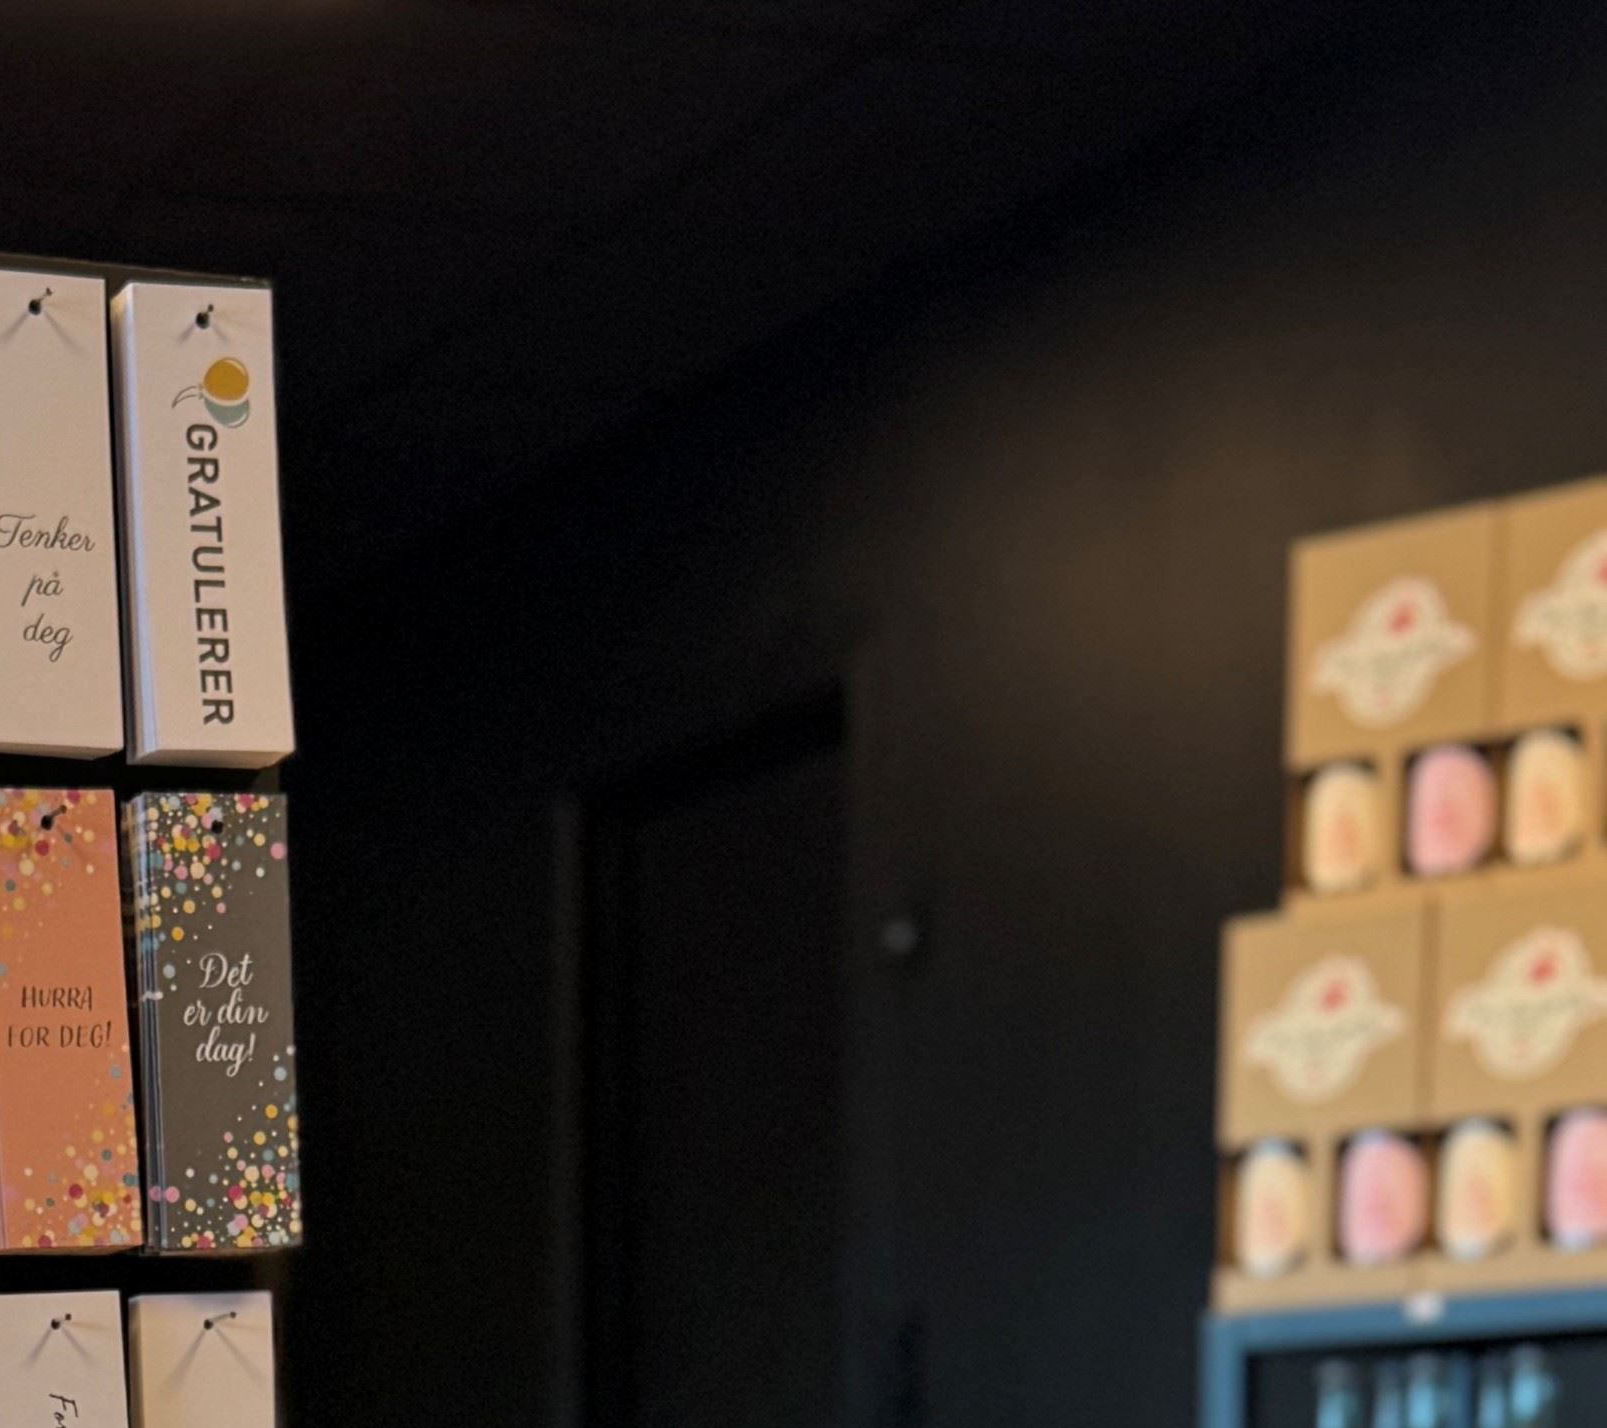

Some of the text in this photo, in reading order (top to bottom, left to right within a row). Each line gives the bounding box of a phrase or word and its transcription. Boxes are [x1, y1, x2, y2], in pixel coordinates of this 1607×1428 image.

[22, 570, 64, 606] på
[185, 422, 235, 726] GRATULERER
[23, 616, 72, 662] deg
[198, 952, 254, 989] Det
[21, 983, 94, 1011] HURRA
[183, 989, 269, 1029] er din
[7, 1019, 112, 1049] FOR DEG!
[195, 1031, 256, 1079] dag!
